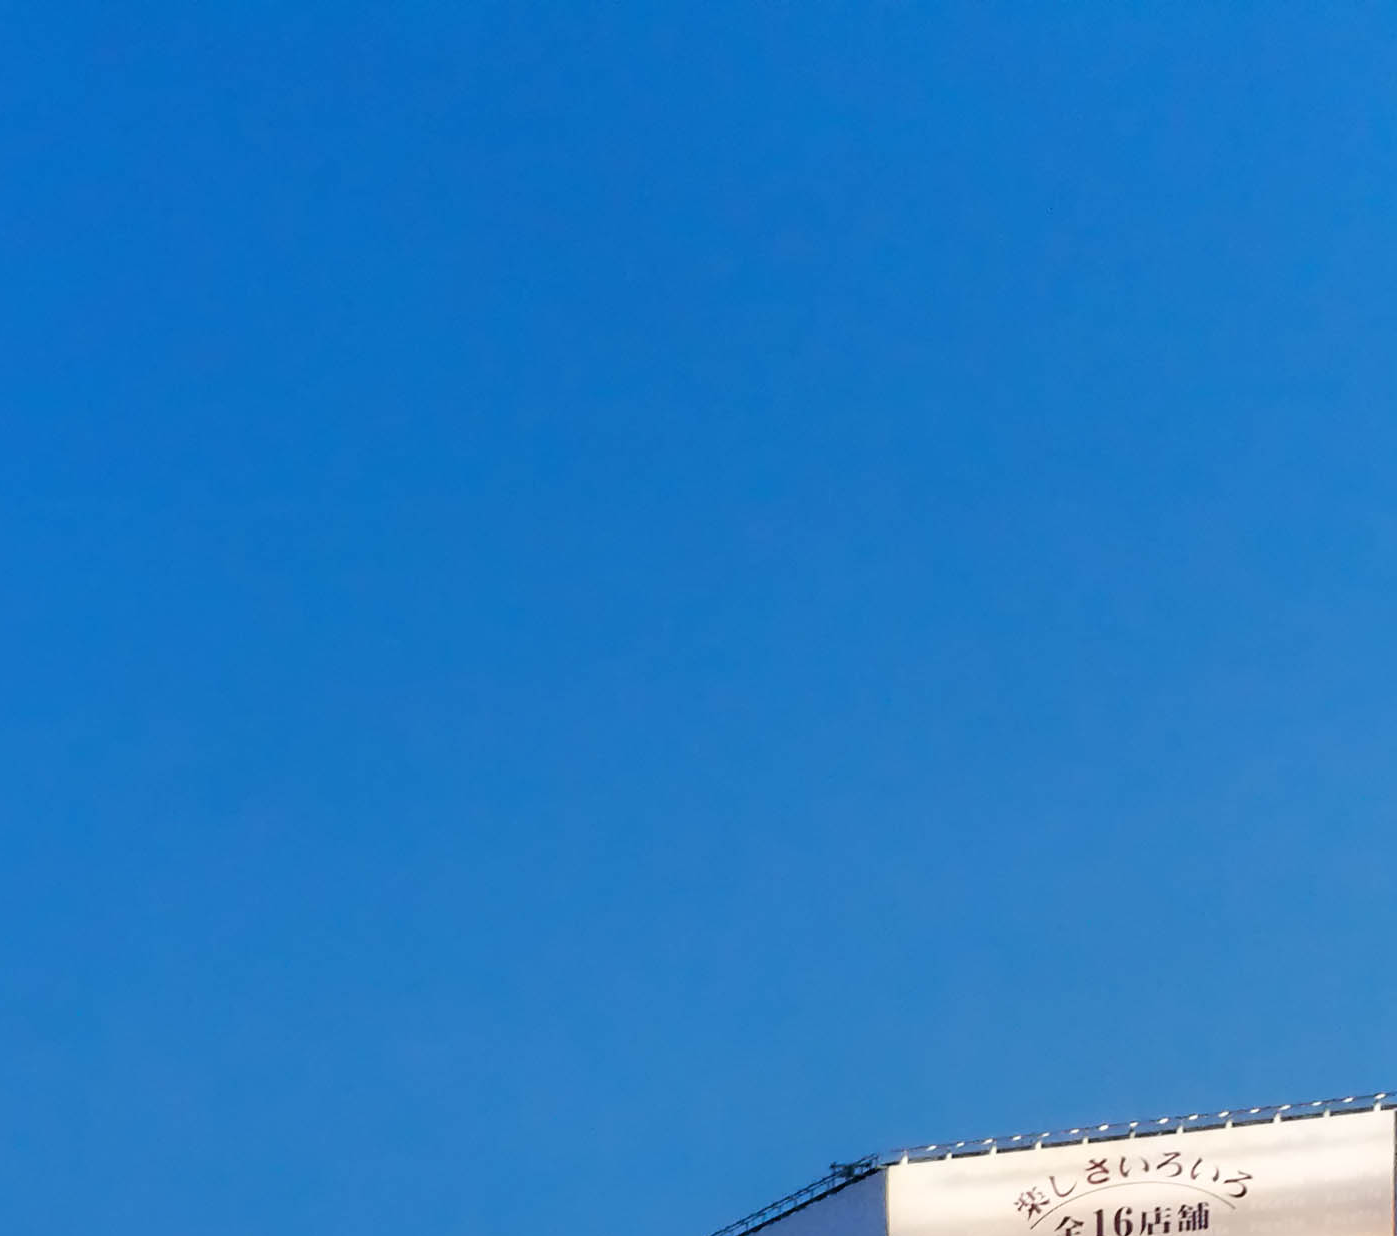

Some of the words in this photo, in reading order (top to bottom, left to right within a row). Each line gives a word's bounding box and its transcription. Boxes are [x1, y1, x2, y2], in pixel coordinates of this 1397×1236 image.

[1014, 1151, 1253, 1220] 楽しさいろいろ
